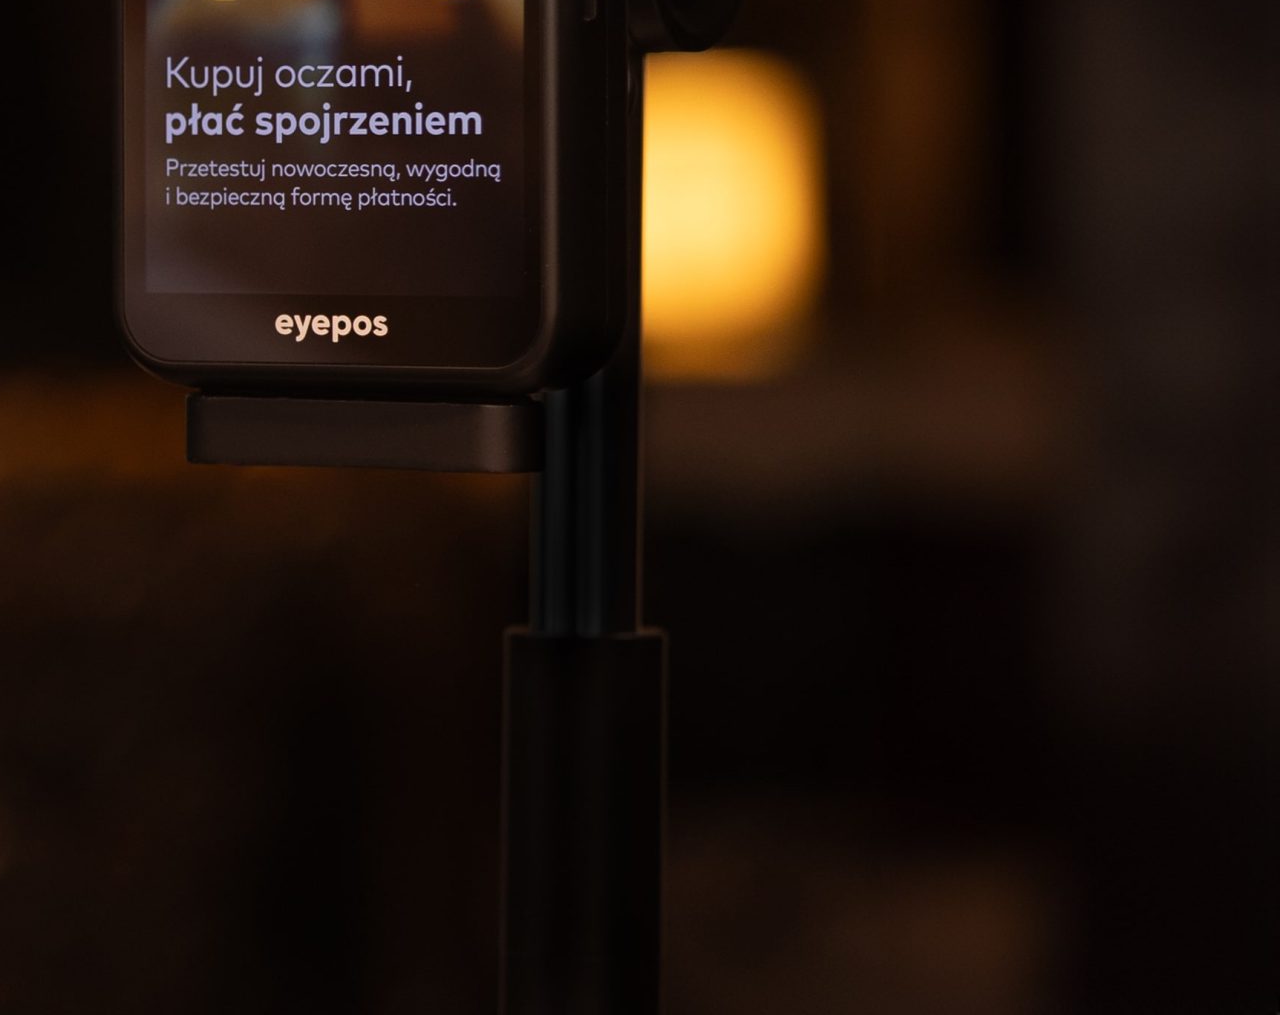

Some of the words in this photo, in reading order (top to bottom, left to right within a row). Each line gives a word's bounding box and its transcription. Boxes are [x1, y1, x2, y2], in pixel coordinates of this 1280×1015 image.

[166, 56, 263, 97] Kupuj
[275, 55, 412, 93] oczami,
[165, 102, 244, 144] płać
[254, 102, 483, 144] spojrzeniem
[165, 158, 266, 182] Przetestuj
[272, 163, 401, 182] nowoczesną,
[405, 158, 502, 183] wygodną
[165, 187, 171, 206] i
[176, 187, 286, 211] bezpieczną
[290, 186, 353, 211] formę
[358, 187, 458, 211] płatności.
[274, 314, 389, 343] eyepos
